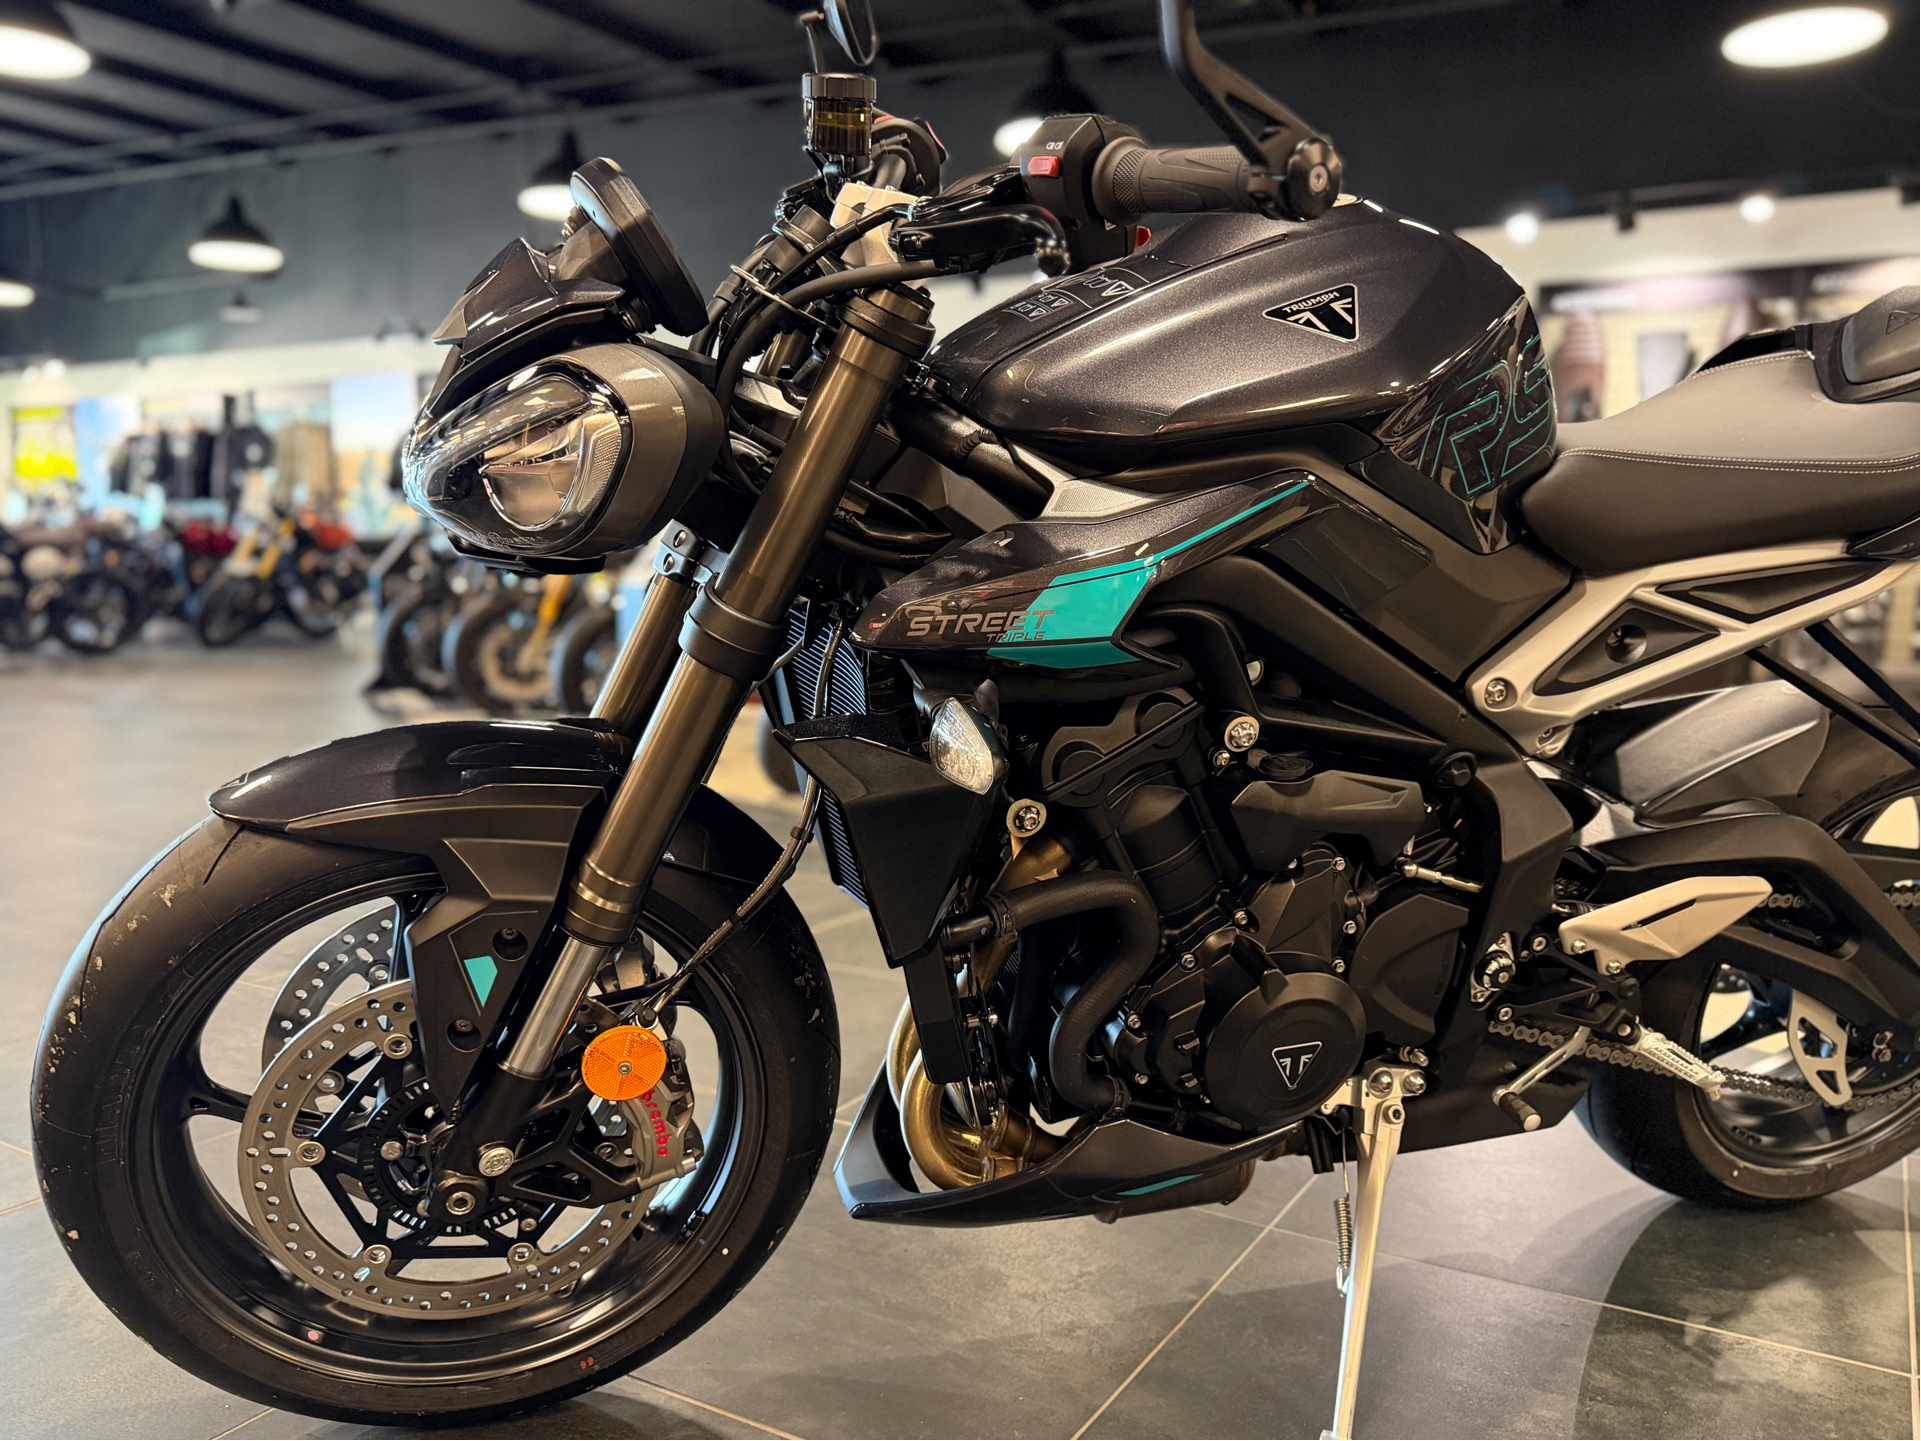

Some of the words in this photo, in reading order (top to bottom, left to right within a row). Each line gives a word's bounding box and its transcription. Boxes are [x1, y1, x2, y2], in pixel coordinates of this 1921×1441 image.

[1281, 291, 1340, 314] TRIUMPH
[1416, 334, 1552, 494] RS
[906, 609, 1056, 637] STREET
[985, 630, 1047, 643] TRIPLE
[640, 1088, 673, 1157] brembo
